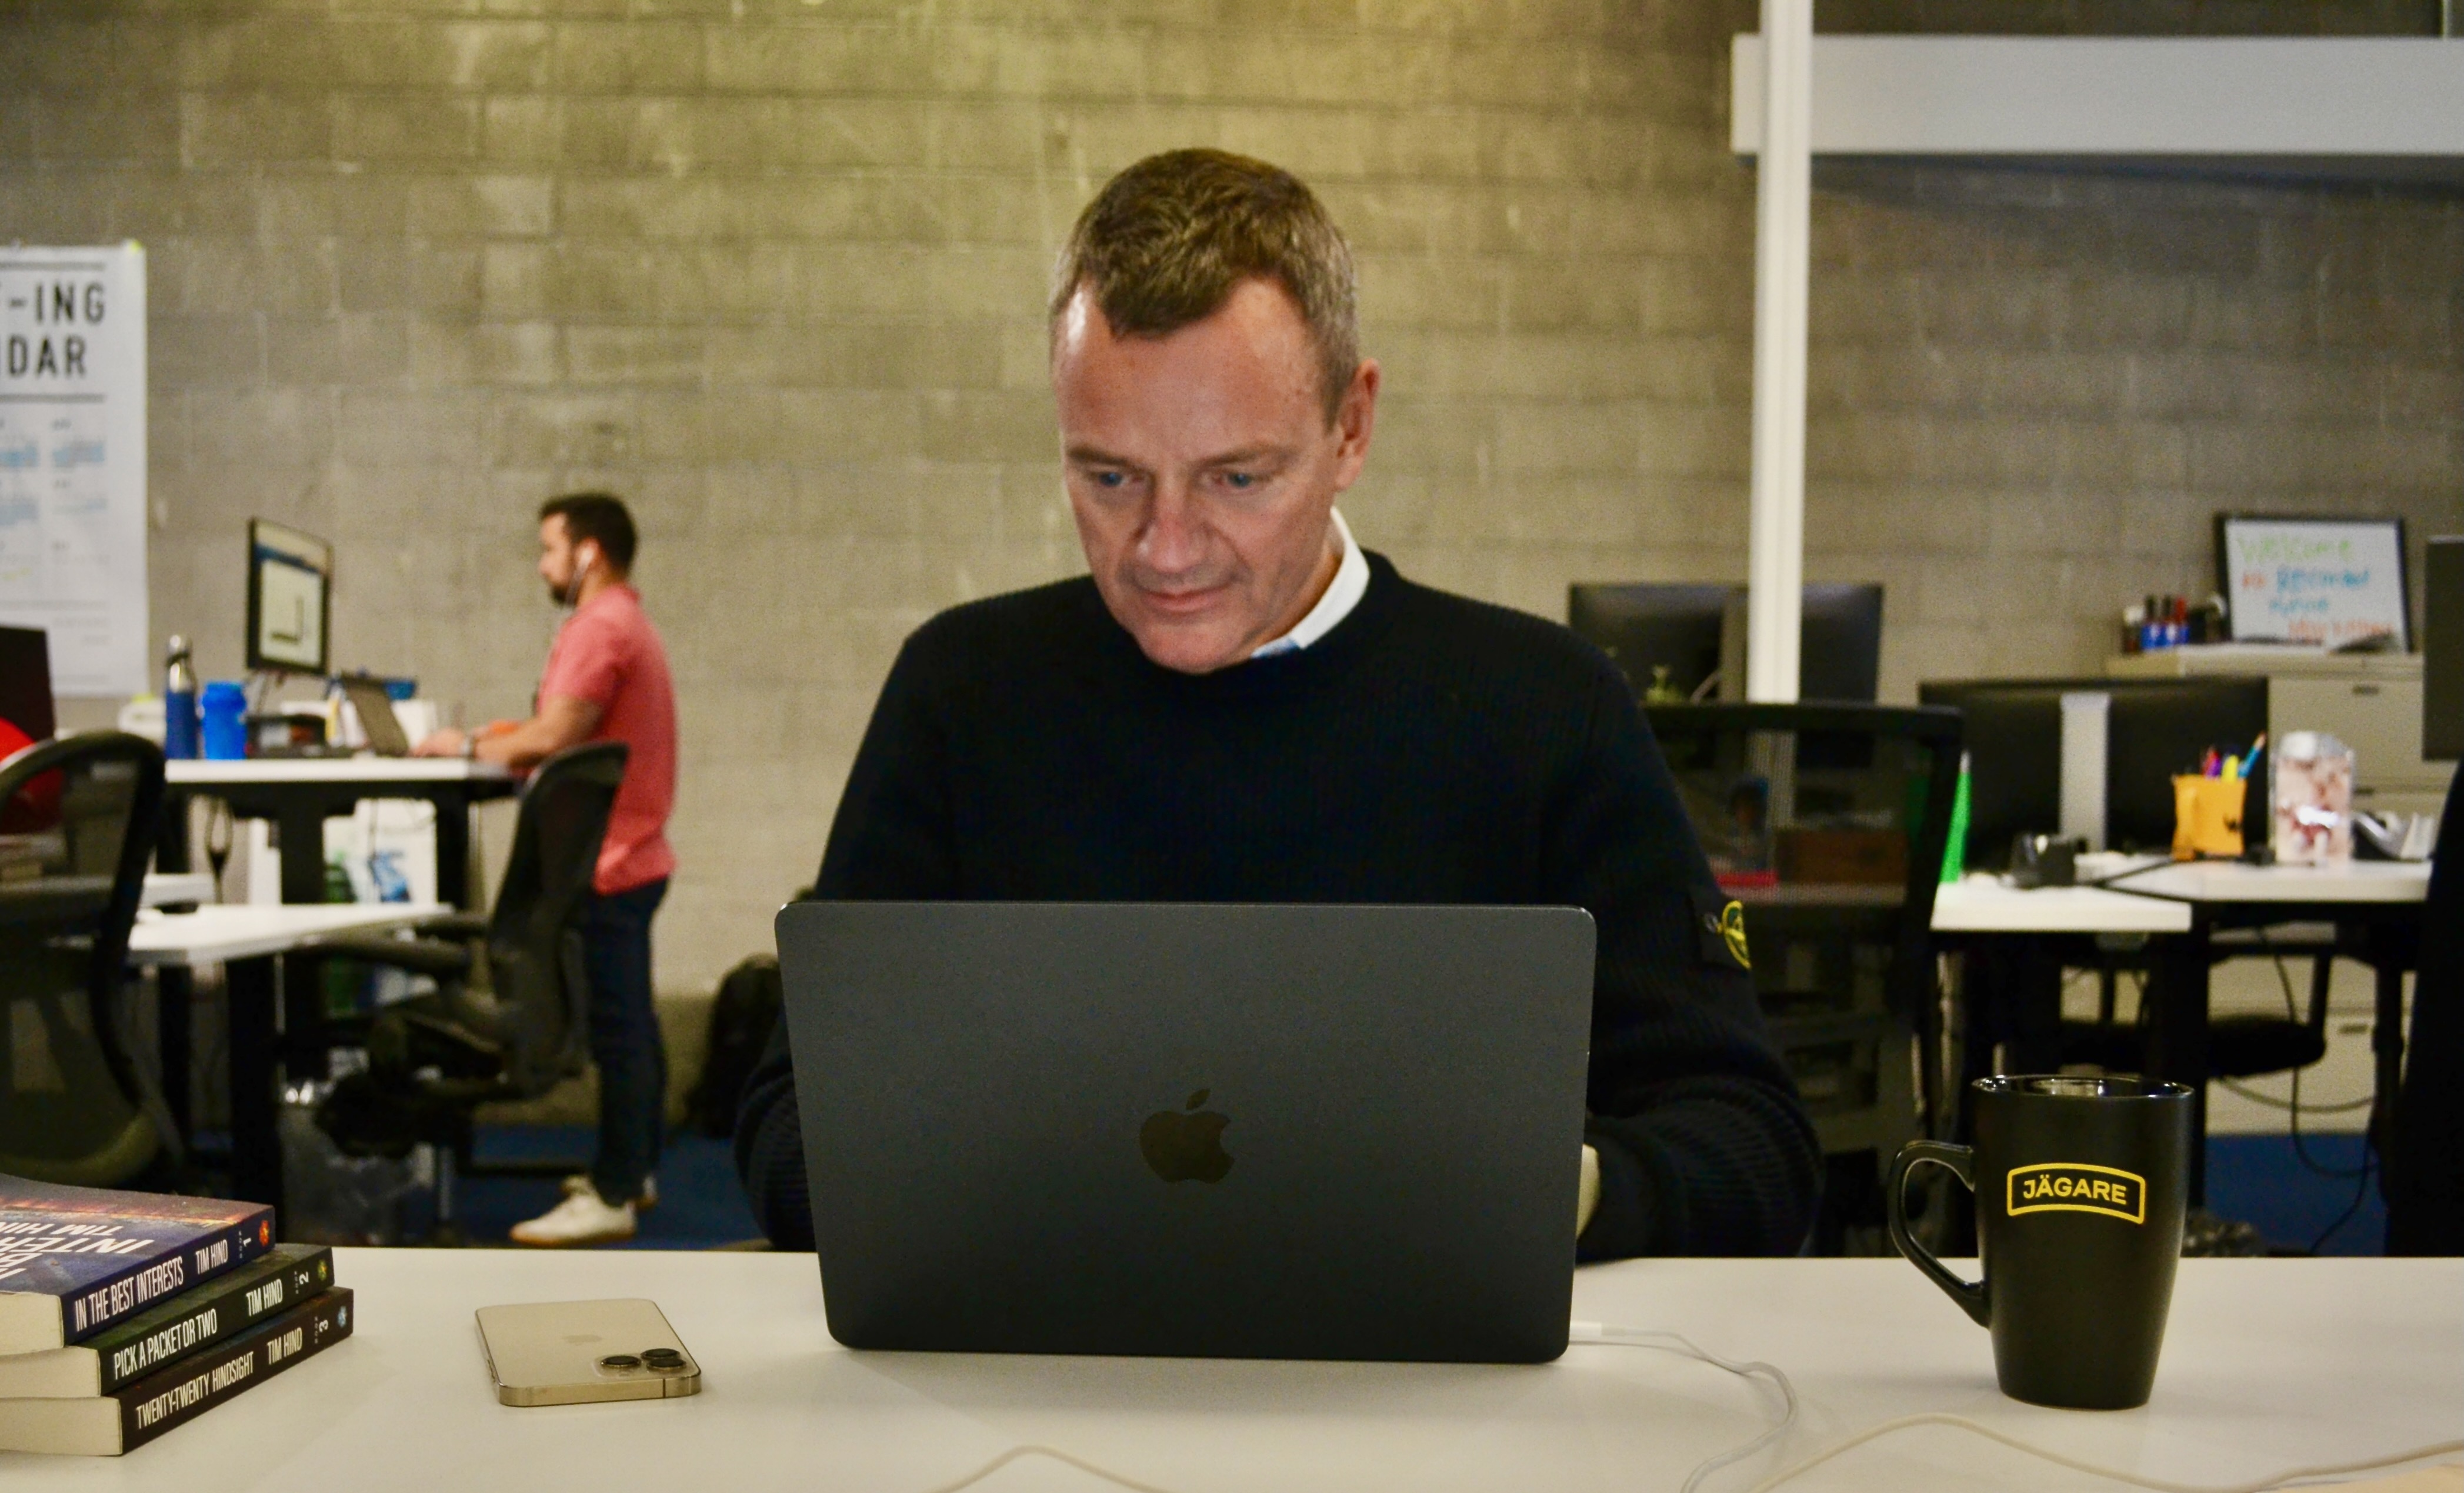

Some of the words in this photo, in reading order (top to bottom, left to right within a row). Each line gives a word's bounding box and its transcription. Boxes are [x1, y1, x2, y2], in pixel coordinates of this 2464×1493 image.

[0, 281, 105, 325] -ING
[0, 334, 86, 377] DAR
[2023, 1174, 2127, 1205] JÄGARE
[51, 1224, 124, 1235] TIM
[243, 1238, 251, 1247] 1
[195, 1247, 209, 1275] TIM
[211, 1239, 228, 1268] HIND
[75, 1297, 88, 1332] IN
[89, 1288, 109, 1325] THE
[111, 1277, 134, 1316] BEST
[136, 1255, 184, 1304] INTERESTS
[299, 1271, 309, 1285] 2
[246, 1291, 263, 1317] TIM
[264, 1278, 283, 1309] HIND
[114, 1349, 138, 1380] PICK
[139, 1341, 146, 1367] A
[147, 1324, 182, 1364] PACKET
[182, 1317, 196, 1347] OR
[196, 1308, 218, 1341] TWO
[319, 1319, 328, 1333] 3
[267, 1337, 282, 1365] TIM
[283, 1327, 302, 1356] HIND
[136, 1372, 210, 1429] TWENTY-TWENTY
[212, 1351, 254, 1392] HINDSIGHT
